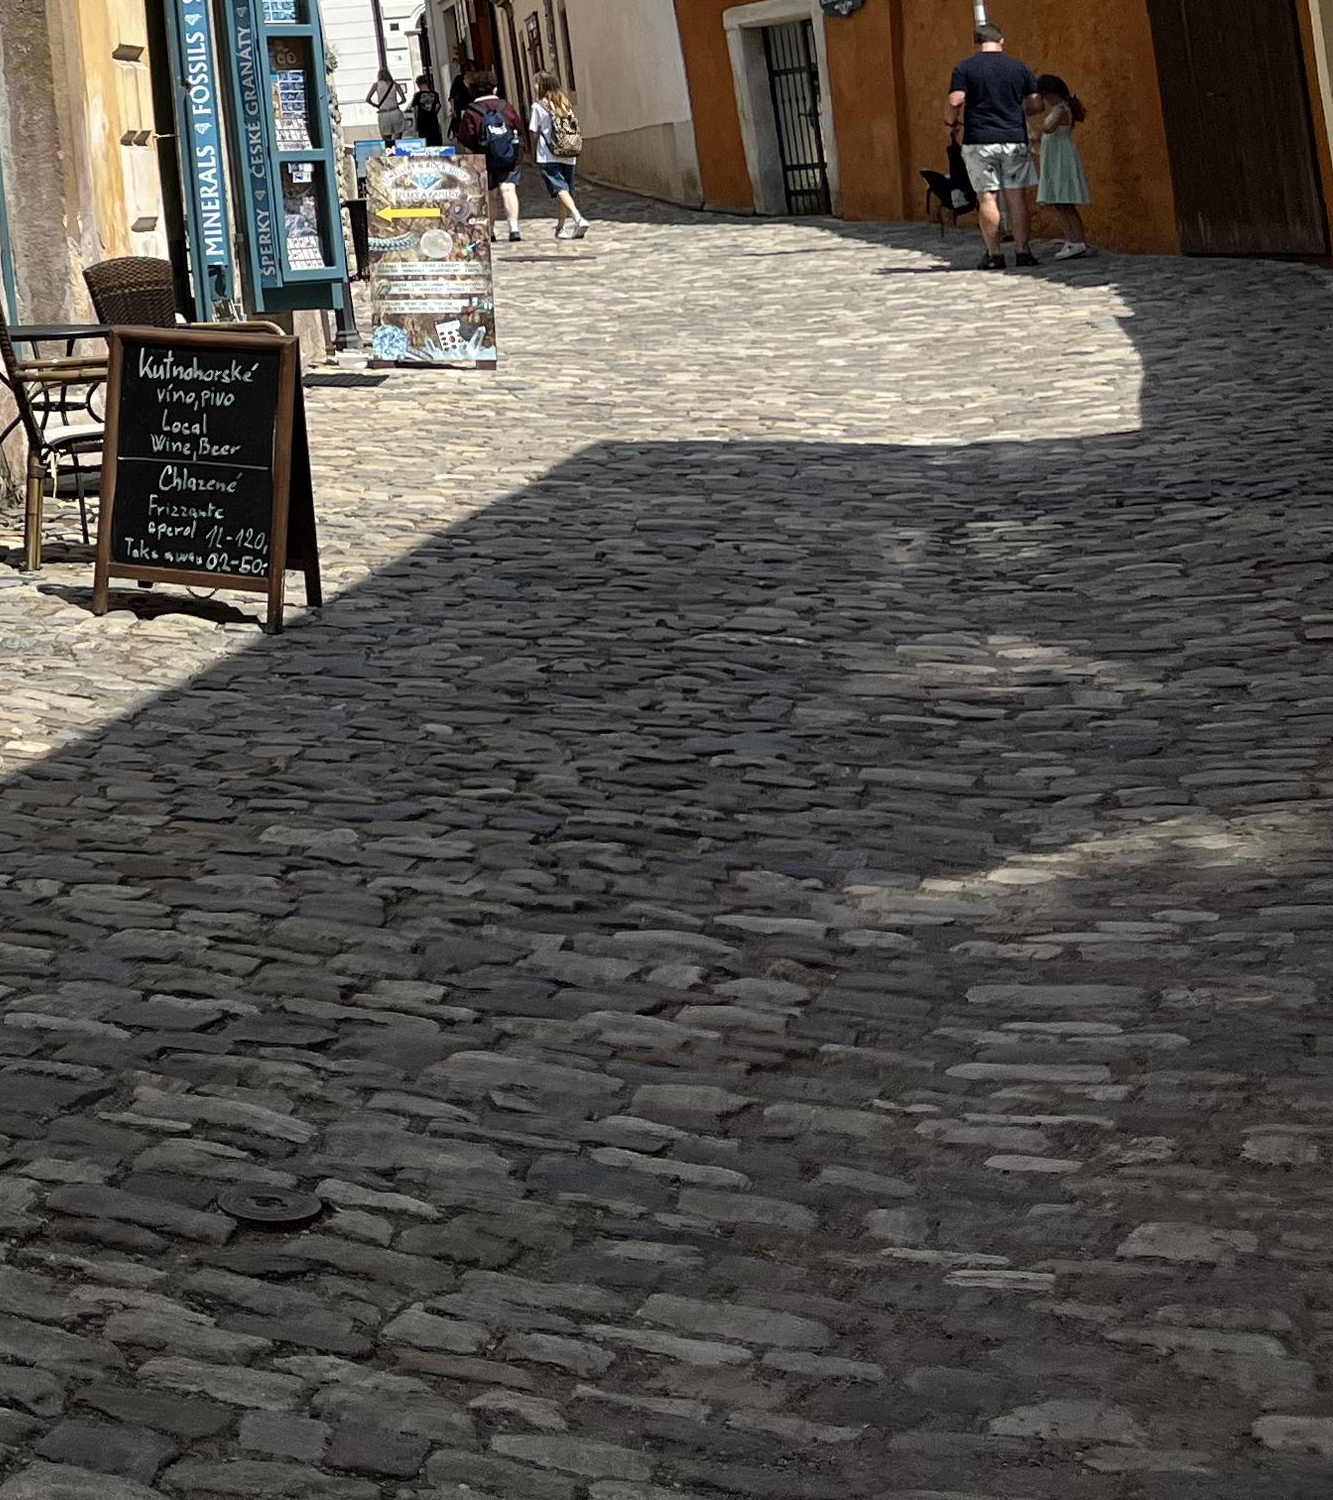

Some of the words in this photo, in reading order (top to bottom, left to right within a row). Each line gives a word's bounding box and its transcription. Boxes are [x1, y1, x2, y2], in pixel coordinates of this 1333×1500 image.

[188, 30, 213, 115] FOSSILS
[237, 25, 261, 114] GRANÁTY
[247, 118, 265, 178] ČESKÉ
[195, 144, 226, 257] MINERALS
[256, 208, 276, 277] ŠPERKY
[139, 347, 259, 384] Kutnohorské
[161, 408, 207, 435] Local
[198, 437, 242, 456] Beer
[158, 465, 243, 493] Chlazené
